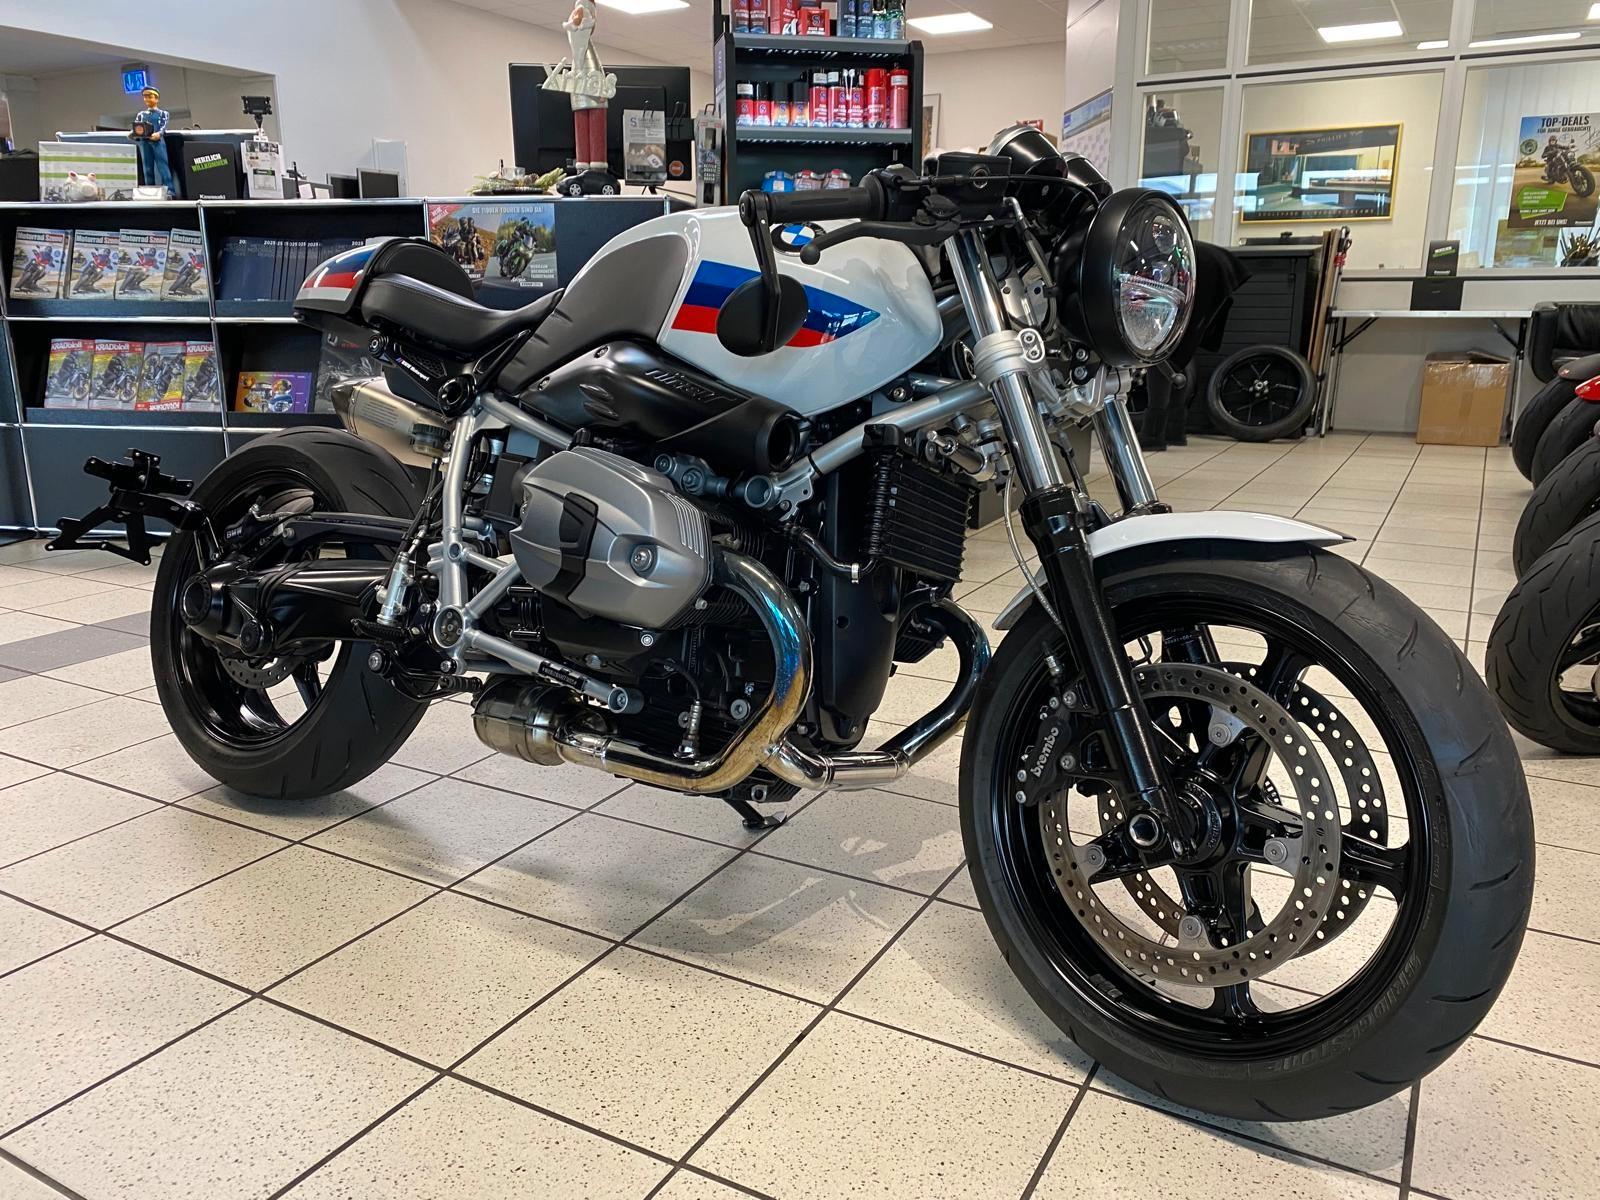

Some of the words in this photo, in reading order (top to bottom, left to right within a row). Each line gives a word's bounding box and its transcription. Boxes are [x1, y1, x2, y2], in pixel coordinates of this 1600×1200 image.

[1541, 115, 1590, 128] TOP-DEALS
[193, 153, 221, 165] HERZLICH
[17, 231, 44, 242] Motorrad
[75, 234, 103, 244] Motorrad
[120, 233, 148, 243] Motorrad
[1030, 727, 1059, 777] brembo
